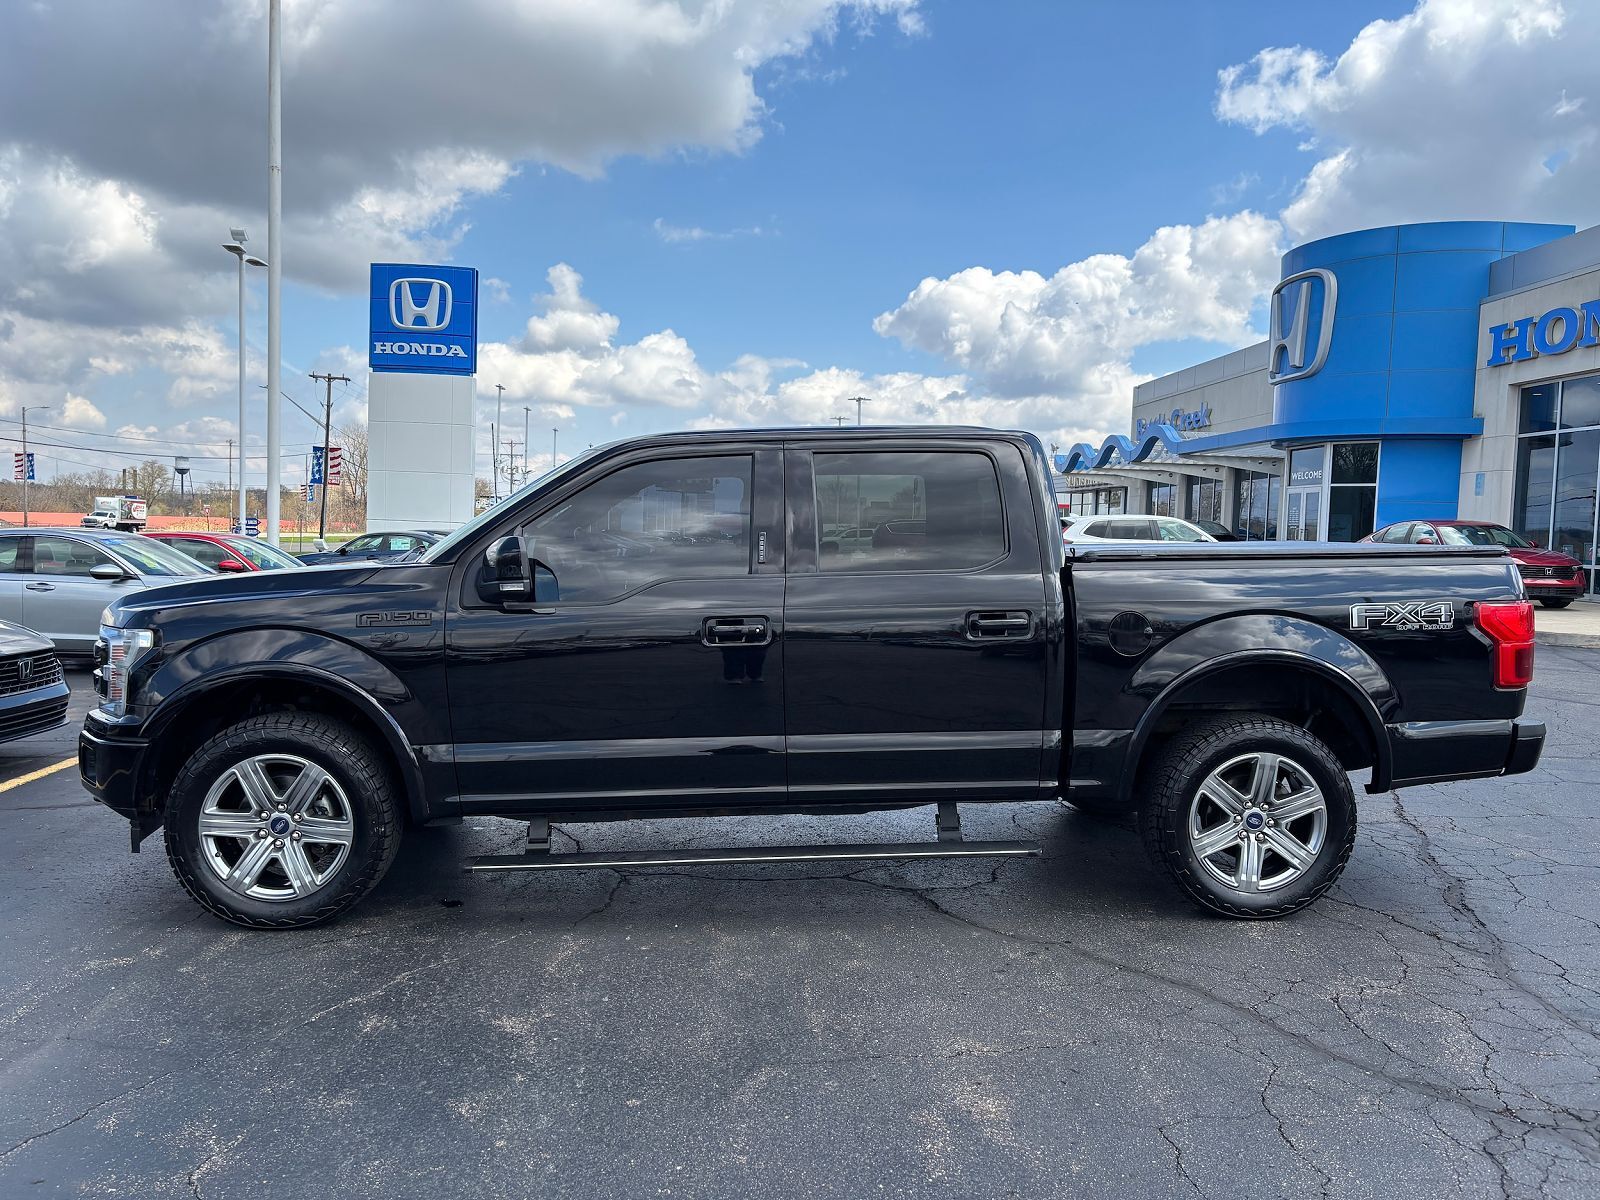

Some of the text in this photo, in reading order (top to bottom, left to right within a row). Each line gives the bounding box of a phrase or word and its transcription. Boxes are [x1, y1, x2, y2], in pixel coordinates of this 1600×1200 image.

[374, 342, 468, 358] HONDA
[1291, 470, 1323, 481] WELCOME
[1350, 602, 1455, 630] FX4
